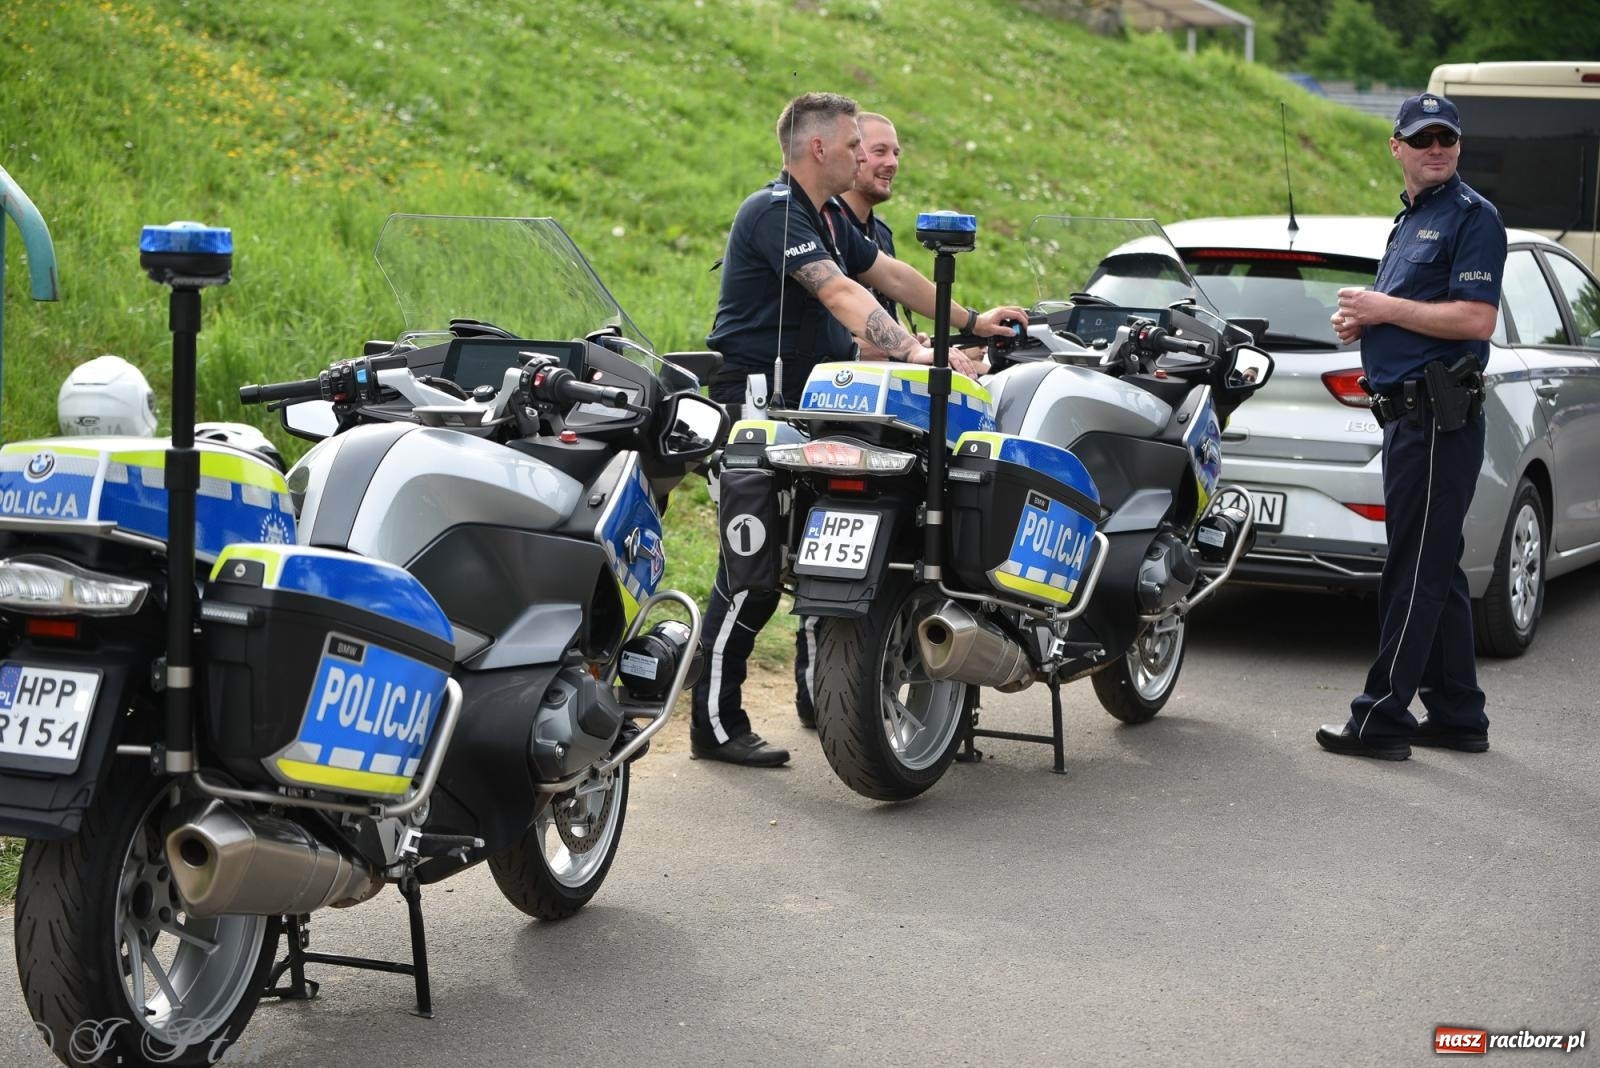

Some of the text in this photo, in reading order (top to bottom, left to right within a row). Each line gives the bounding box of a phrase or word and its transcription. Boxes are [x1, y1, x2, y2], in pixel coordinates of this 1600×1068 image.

[1416, 229, 1440, 241] POLICJA
[785, 240, 817, 257] POLICJA
[1458, 270, 1492, 282] POLICJA
[808, 392, 869, 411] POLICJA
[808, 526, 820, 537] PL
[822, 516, 865, 538] HPP
[1019, 511, 1087, 571] POLICJA
[804, 541, 866, 564] R155
[16, 675, 77, 708] HPP
[316, 666, 432, 745] POLICJA
